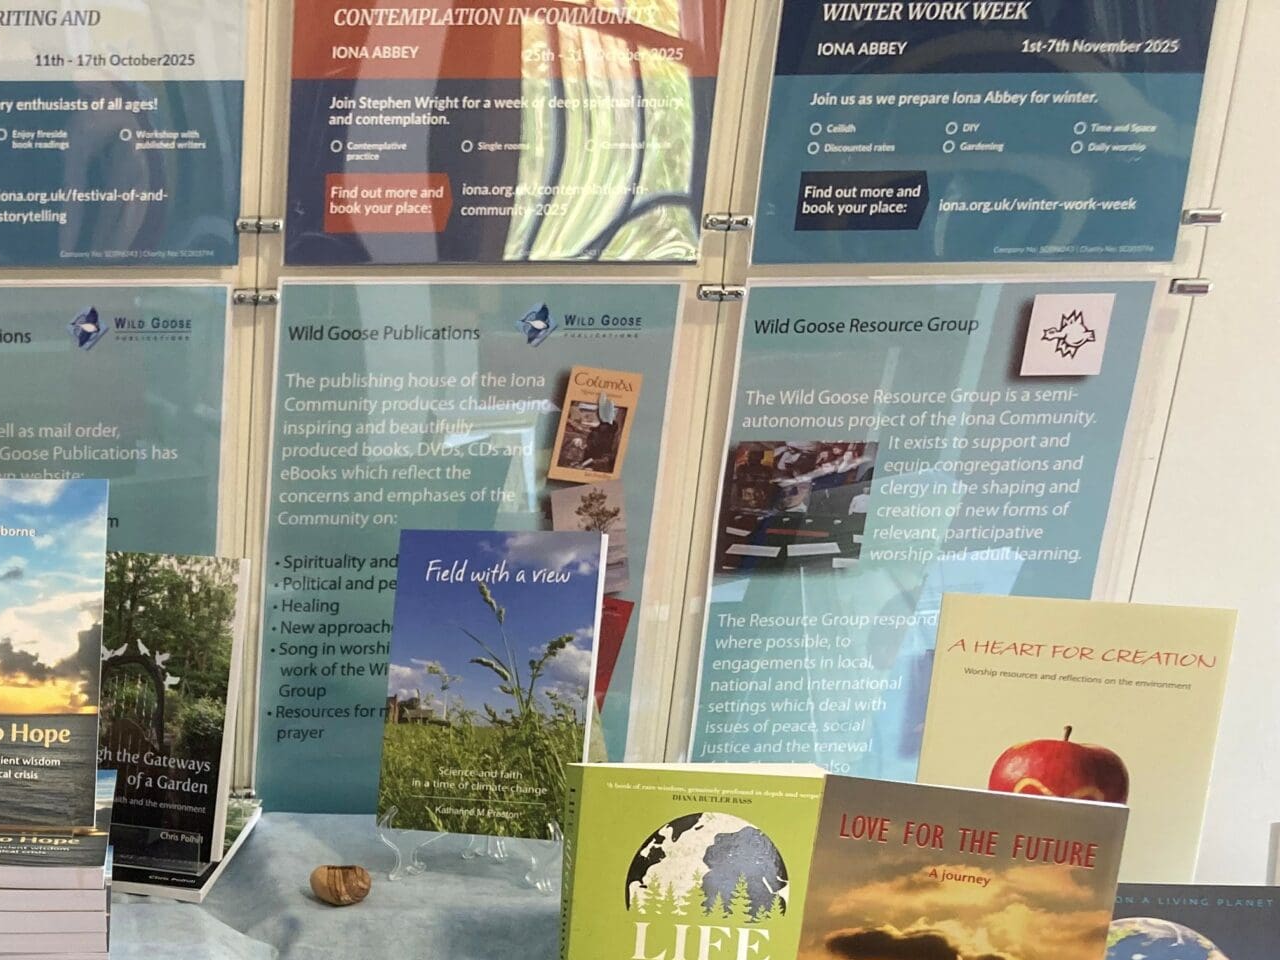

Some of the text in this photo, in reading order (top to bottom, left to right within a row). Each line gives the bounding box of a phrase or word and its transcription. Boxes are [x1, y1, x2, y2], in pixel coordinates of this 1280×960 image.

[60, 10, 101, 26] AND
[334, 7, 529, 27] CONTEMPLATION IN
[823, 2, 1032, 21] WINTER WORK WEEK
[1021, 38, 1179, 54] 1st-7th November 2025
[963, 123, 979, 132] DIY
[959, 142, 1004, 152] Gardening
[939, 198, 1136, 213] iona.org.uk/winter-work-week
[754, 317, 979, 336] Wild Goose Resource Group
[575, 371, 633, 392] Columba
[18, 427, 34, 438] as
[39, 424, 71, 438] mail
[75, 424, 120, 440] order,
[873, 525, 1042, 542] relevant, participative
[425, 560, 570, 584] Field with a view
[282, 599, 339, 615] Healing
[948, 638, 1216, 669] A HEART FOR CREATION
[279, 683, 327, 699] Group
[708, 696, 887, 715] settings which deal with
[10, 724, 70, 748] Hope
[277, 727, 324, 741] prayer
[23, 756, 61, 767] wisdom
[116, 750, 210, 772] the Gateways
[14, 769, 38, 779] crisis
[127, 772, 208, 794] of a Garden
[160, 832, 180, 842] Chris
[839, 813, 1098, 868] LOVE FOR THE FUTURE
[929, 869, 991, 887] A journey
